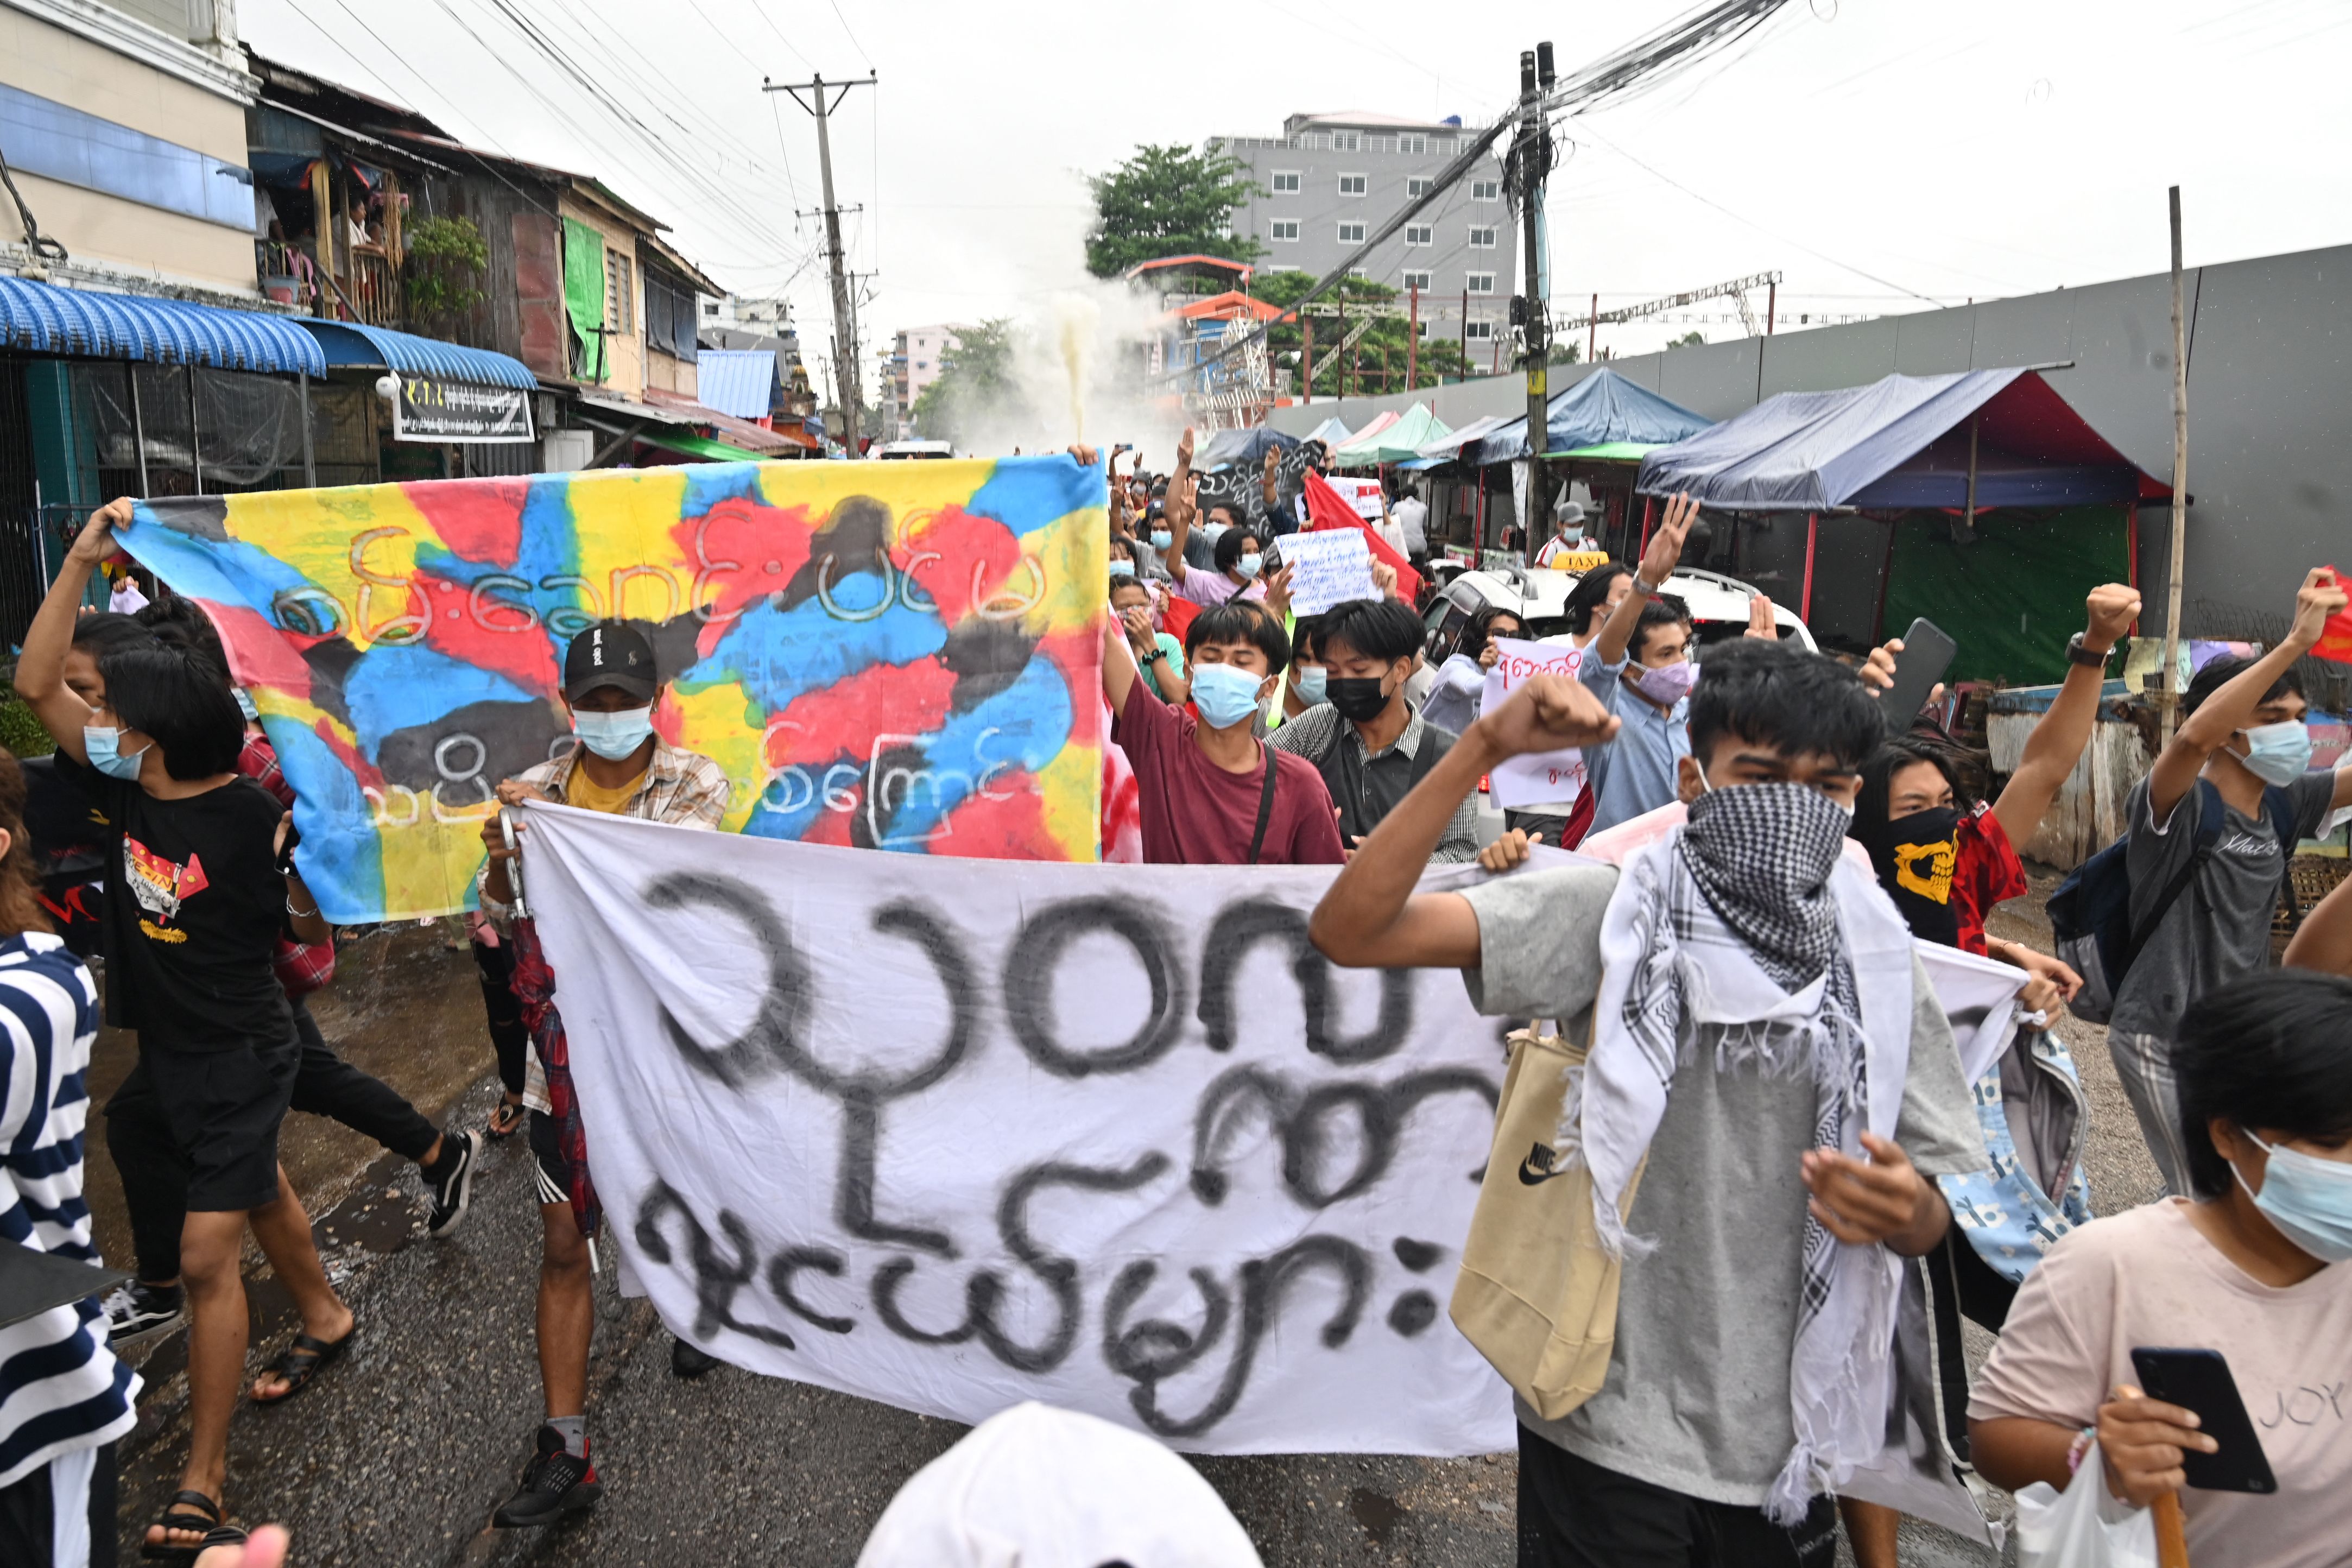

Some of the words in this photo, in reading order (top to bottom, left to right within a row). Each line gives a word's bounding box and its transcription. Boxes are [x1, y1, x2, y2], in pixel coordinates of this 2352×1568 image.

[1566, 556, 1601, 568] TAXI
[1528, 1142, 1557, 1172] NIKE
[2258, 1381, 2345, 1428] JOY
